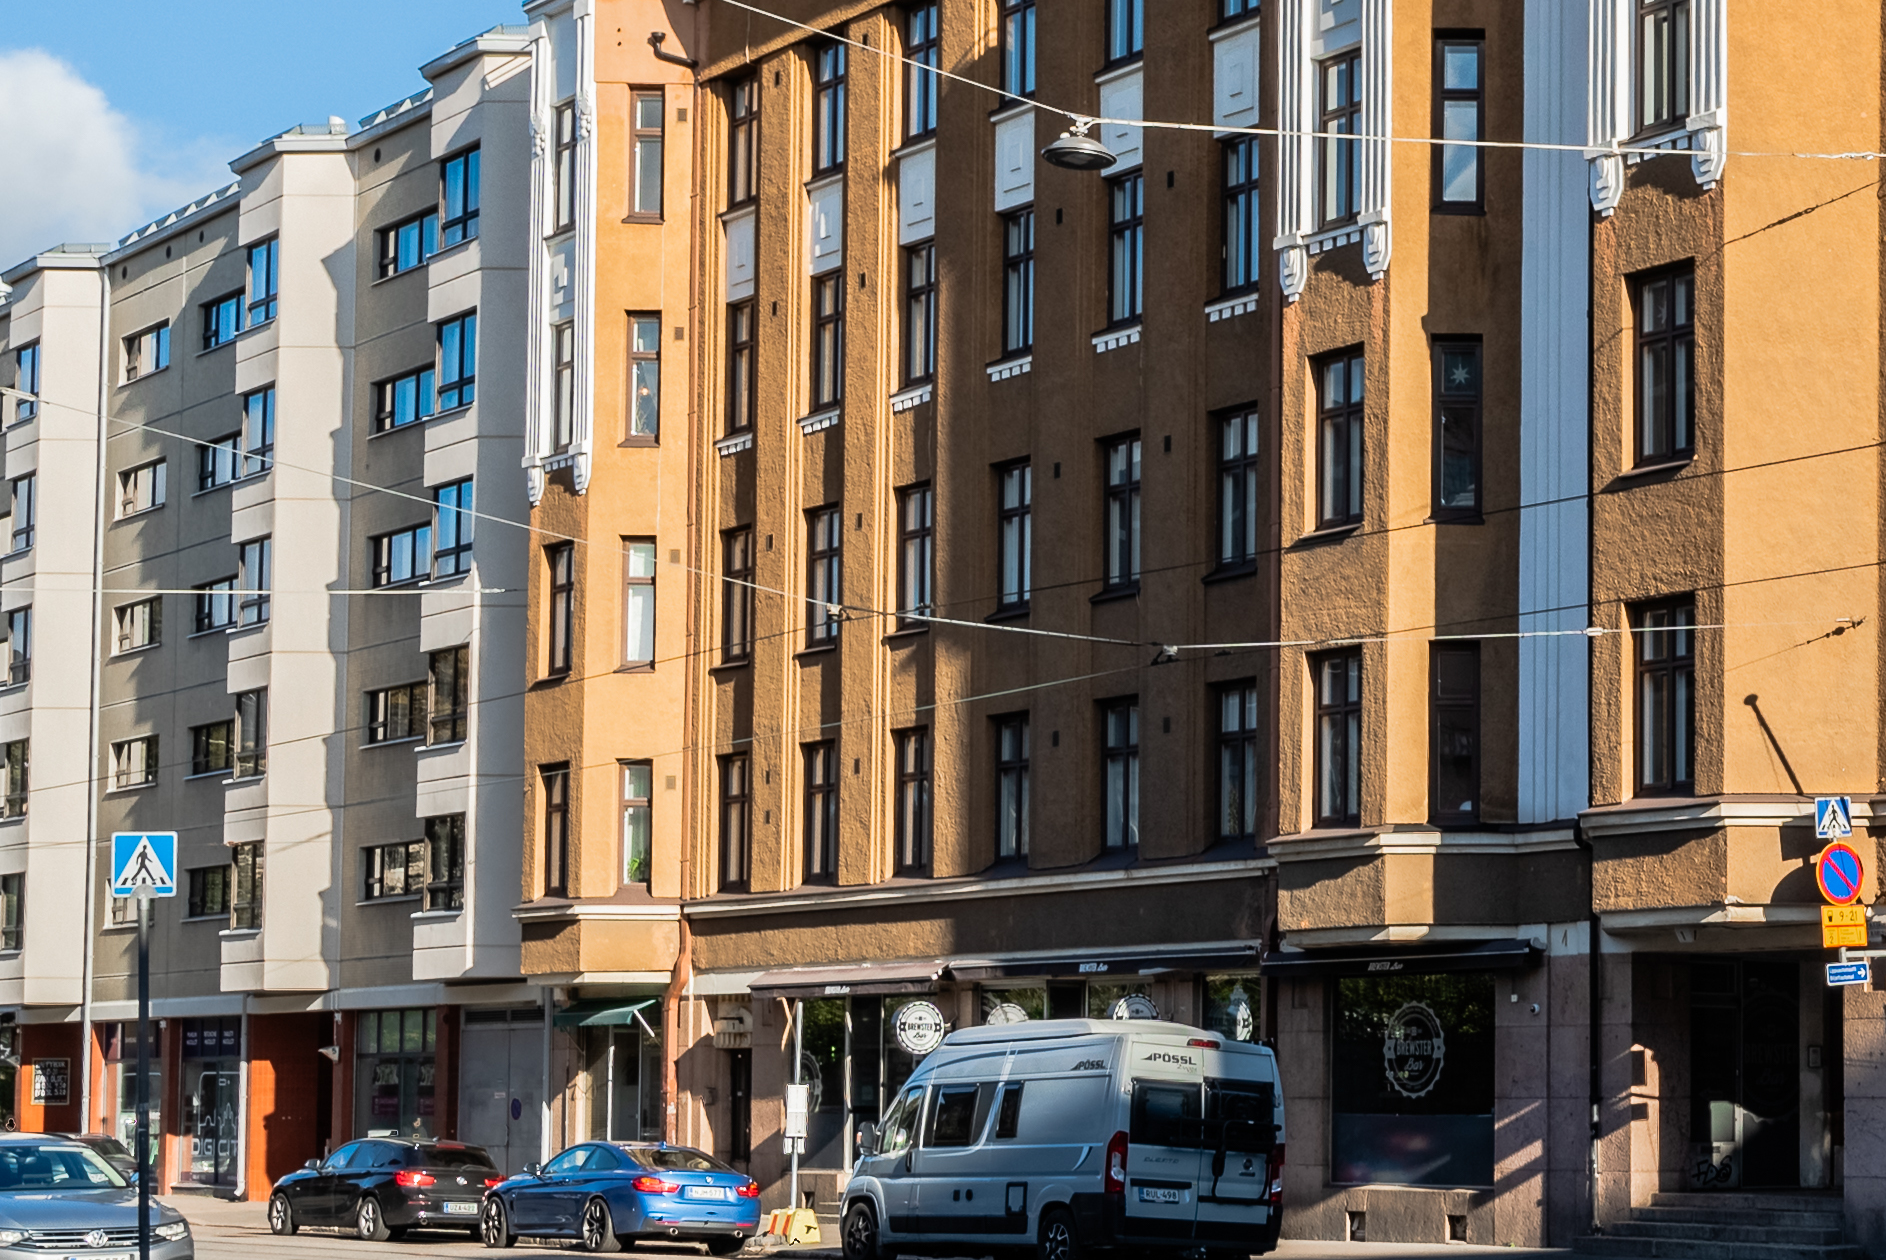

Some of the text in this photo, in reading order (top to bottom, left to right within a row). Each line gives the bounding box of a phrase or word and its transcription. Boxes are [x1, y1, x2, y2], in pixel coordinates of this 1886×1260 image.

[907, 1023, 933, 1031] BREWSTER
[1397, 1040, 1432, 1056] BREWSTER
[1078, 1059, 1106, 1070] PÖSSL
[1153, 1053, 1197, 1065] PÖSSL
[1404, 1057, 1425, 1071] Bar
[1145, 1189, 1177, 1200] RUL-498
